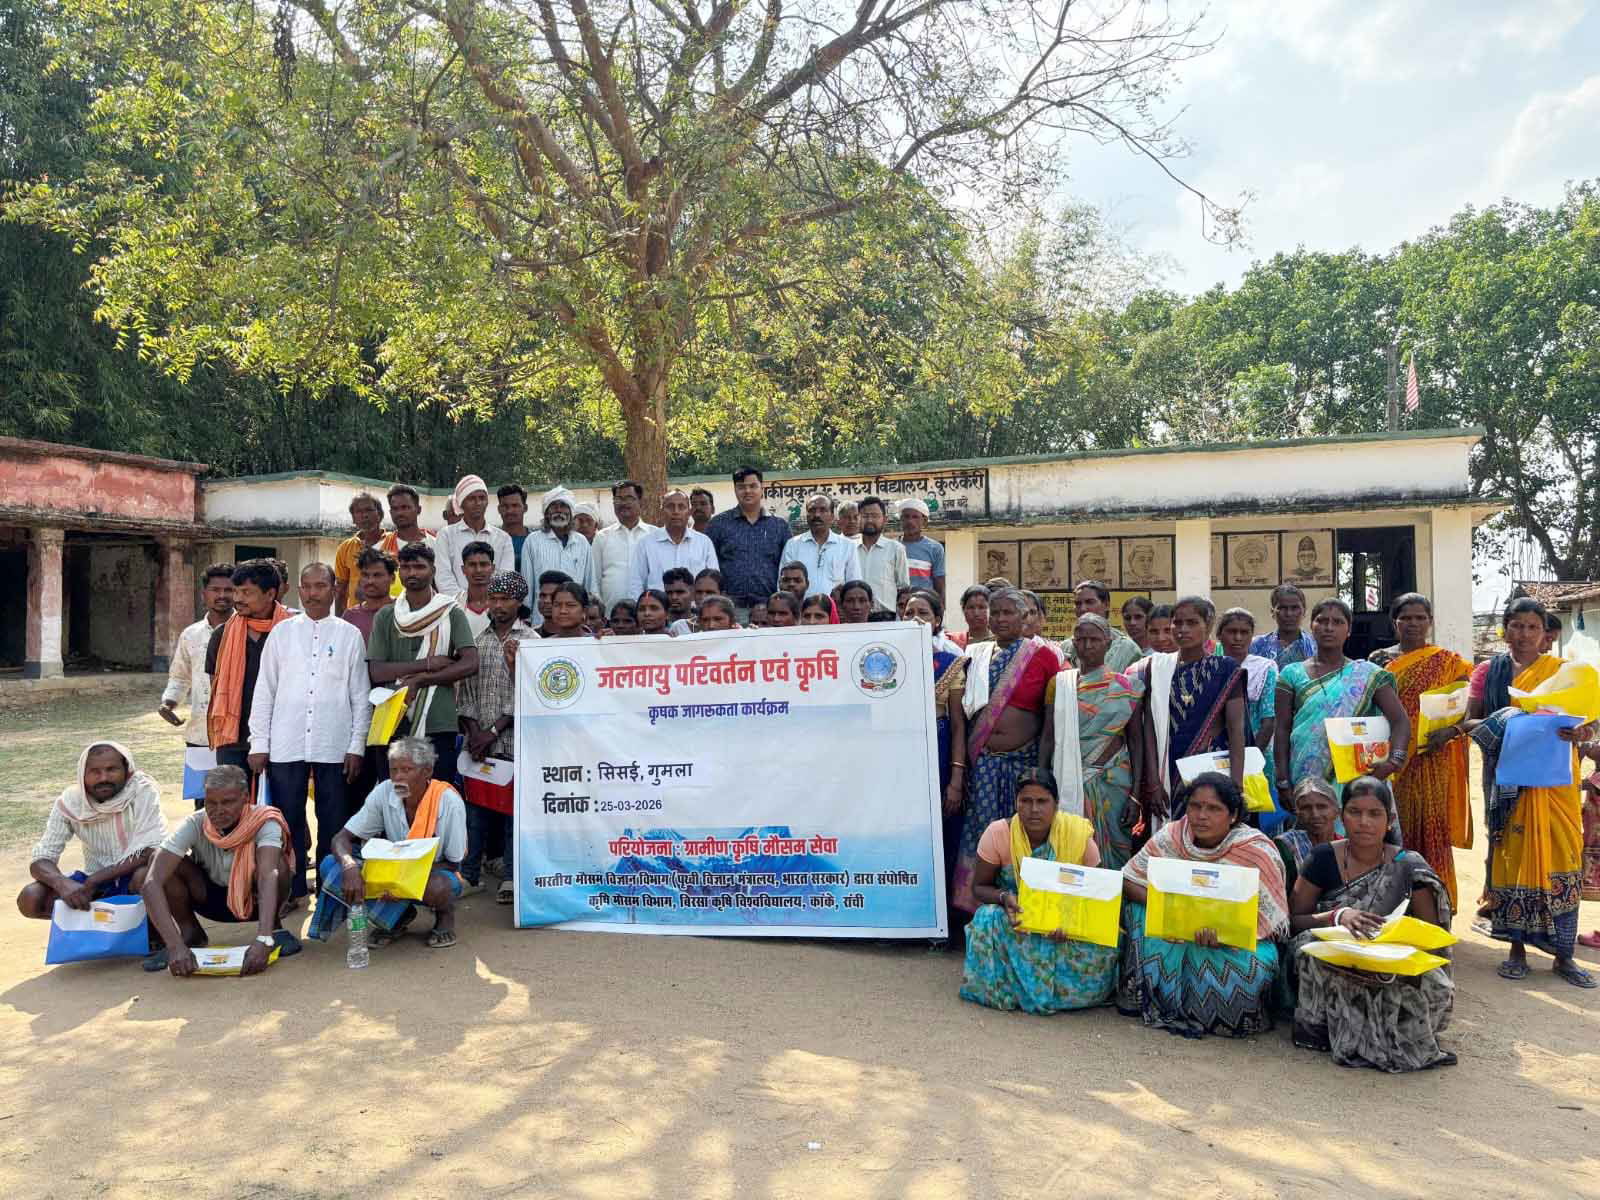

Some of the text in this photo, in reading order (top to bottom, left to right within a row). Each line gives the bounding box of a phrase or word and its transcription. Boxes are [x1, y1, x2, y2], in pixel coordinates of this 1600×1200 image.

[838, 481, 872, 496] मध्य
[595, 649, 840, 695] जलवायु परिवर्तन एवं कृषि
[648, 703, 679, 725] कृषक
[740, 698, 789, 716] कार्यक्रम
[598, 761, 644, 783] सिसई,
[648, 763, 693, 786] गुमला
[600, 799, 663, 812] 25-03-2026
[682, 836, 728, 856] ग्रामीण
[731, 835, 760, 863] कृषि
[760, 834, 806, 856] मौसम
[808, 834, 838, 855] सेवा
[534, 873, 572, 888] भारतीय
[575, 871, 603, 885] मौसम
[605, 871, 636, 886] विज्ञान
[638, 871, 670, 885] विभाग
[703, 871, 735, 886] विज्ञान
[737, 871, 779, 887] मंत्रालय,
[782, 872, 808, 886] भारत
[810, 870, 849, 887] सरकार)
[877, 870, 918, 886] संपोषित
[589, 892, 864, 911] कृषि मौसम विभाग, बिरसा कृषि विश्वविद्यालय, कांके, रांची
